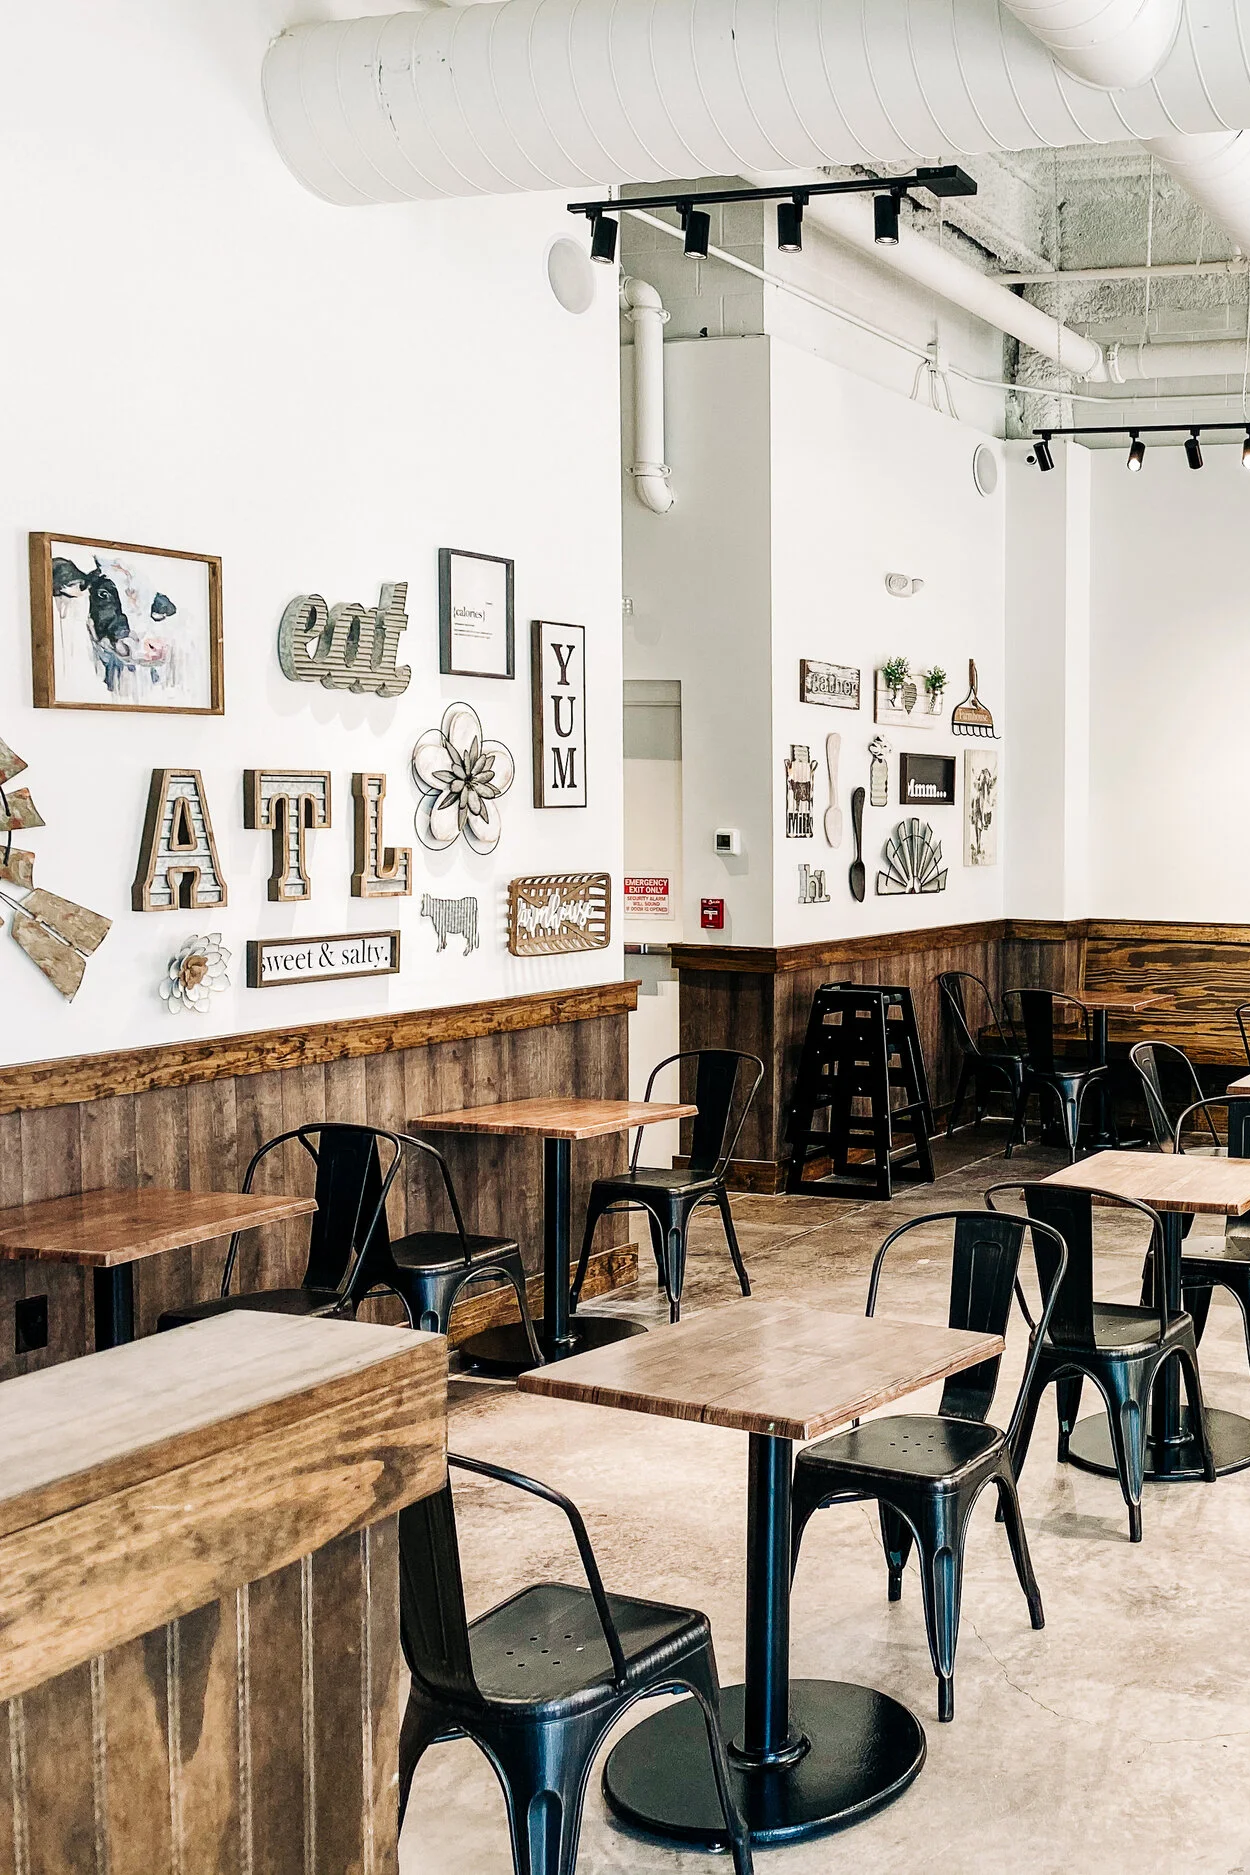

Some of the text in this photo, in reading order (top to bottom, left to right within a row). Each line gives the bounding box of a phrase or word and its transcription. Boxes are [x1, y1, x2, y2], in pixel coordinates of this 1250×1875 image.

[278, 582, 411, 697] eat
[550, 643, 577, 789] YUM
[788, 813, 814, 834] Milk
[624, 878, 668, 886] EMERGENCY
[318, 942, 336, 968] &
[341, 939, 388, 968] salty.
